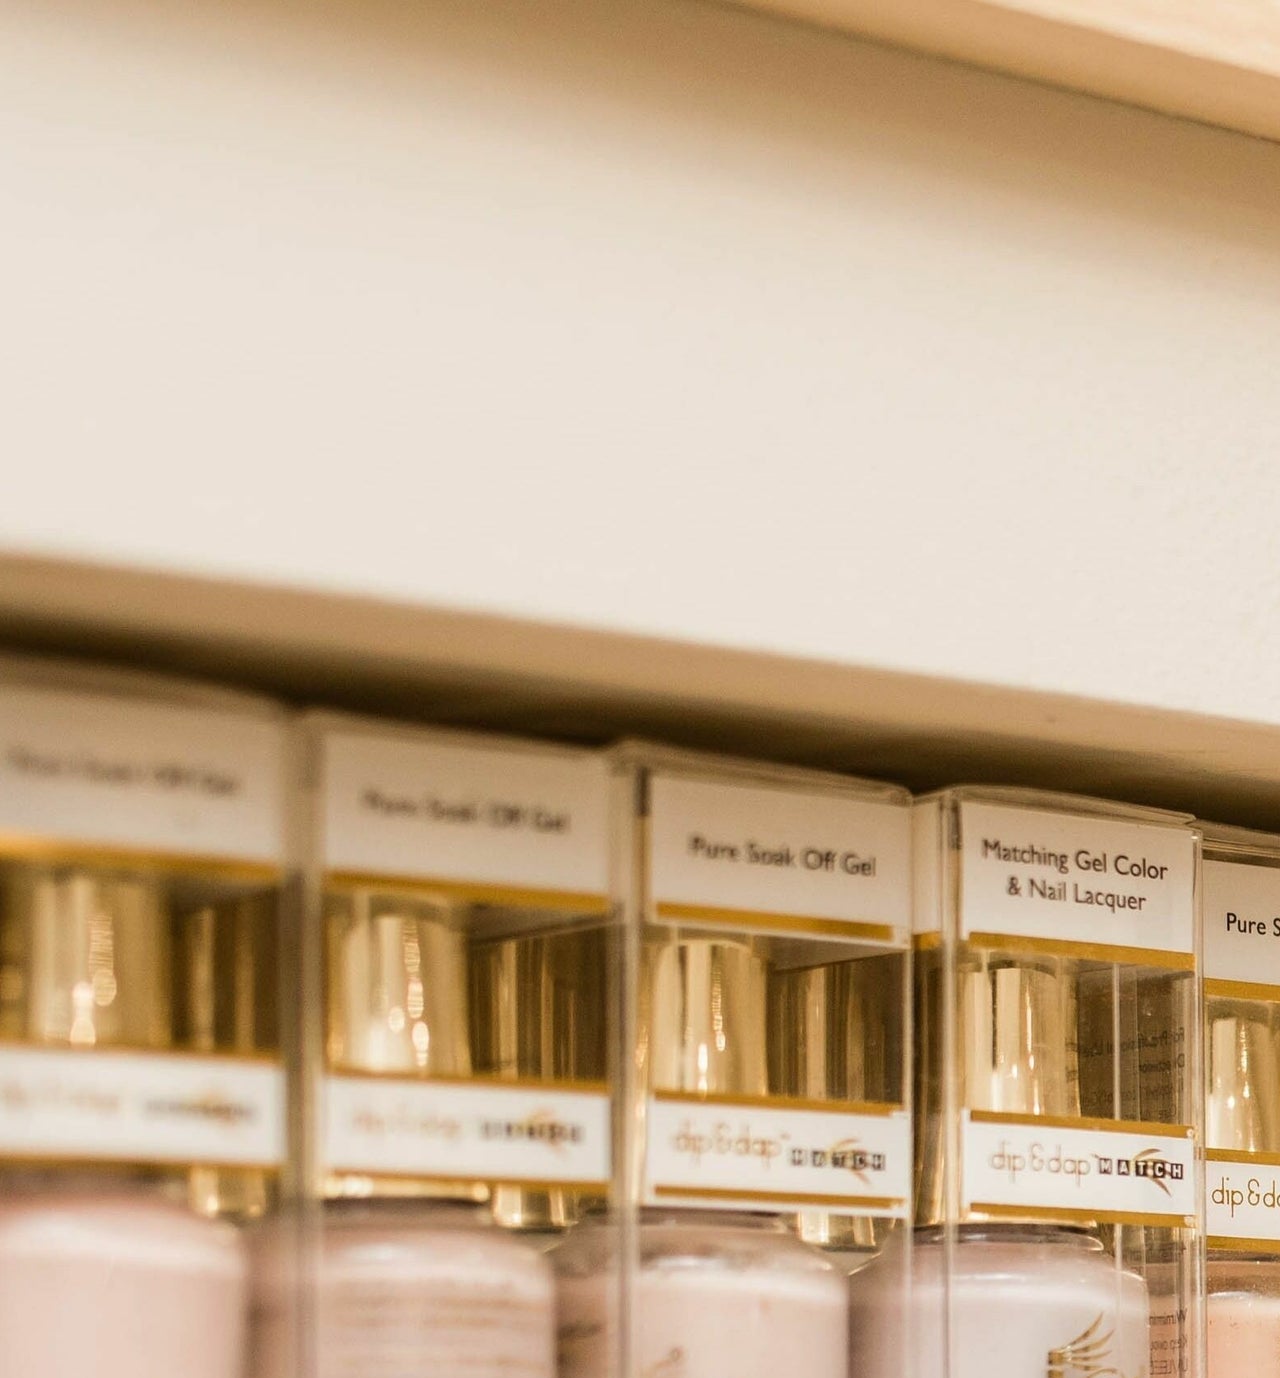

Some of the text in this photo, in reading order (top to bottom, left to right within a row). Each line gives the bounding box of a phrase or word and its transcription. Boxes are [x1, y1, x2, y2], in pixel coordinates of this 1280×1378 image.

[803, 847, 837, 872] Off
[843, 852, 877, 877] Gel
[981, 838, 1169, 880] Matching Gel Color
[1006, 876, 1146, 913] & Nail Lacquer
[1226, 912, 1266, 935] Pure
[1099, 1156, 1184, 1180] MATCH
